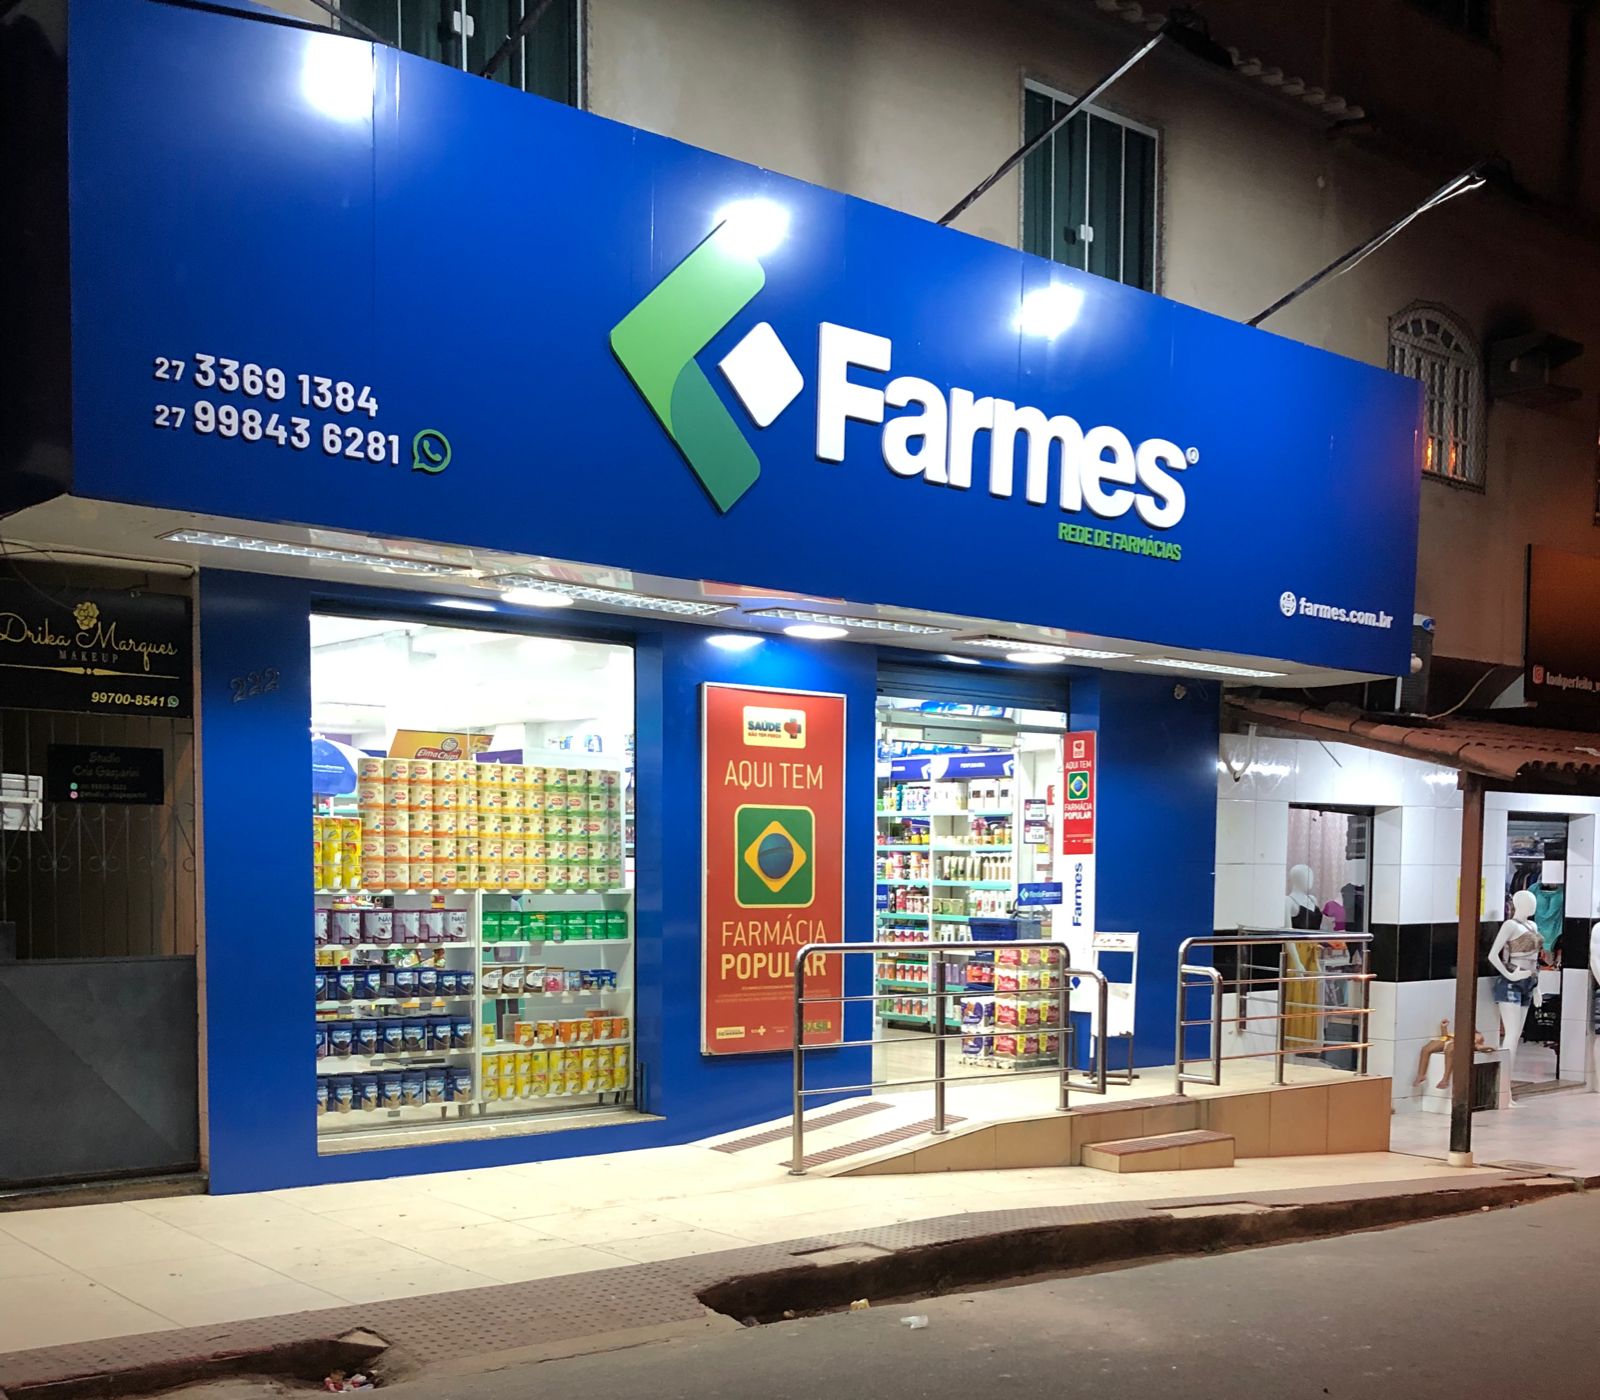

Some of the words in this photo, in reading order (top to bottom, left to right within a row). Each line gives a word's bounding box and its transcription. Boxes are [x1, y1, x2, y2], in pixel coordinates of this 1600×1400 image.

[154, 357, 186, 381] 27
[194, 353, 286, 400] 3369
[297, 373, 379, 417] 1384
[154, 404, 186, 428] 27
[194, 400, 311, 449] 99843
[322, 423, 400, 465] 6281
[1058, 522, 1093, 545] REDE
[1093, 529, 1112, 549] DE
[1112, 534, 1182, 561] FARMÁCIAS
[1299, 597, 1393, 629] farmes.com.br
[0, 612, 71, 648] Drika
[76, 622, 178, 671] Marques
[58, 649, 119, 663] MAKEUP
[91, 691, 165, 707] 99700-8541
[230, 667, 280, 702] 222
[747, 720, 782, 733] SAÚDE
[724, 760, 773, 790] AQUI
[779, 763, 823, 790] TEM
[1064, 811, 1092, 820] POPULAR
[1072, 862, 1083, 927] Farmes
[722, 914, 827, 946] FARMÁCIA
